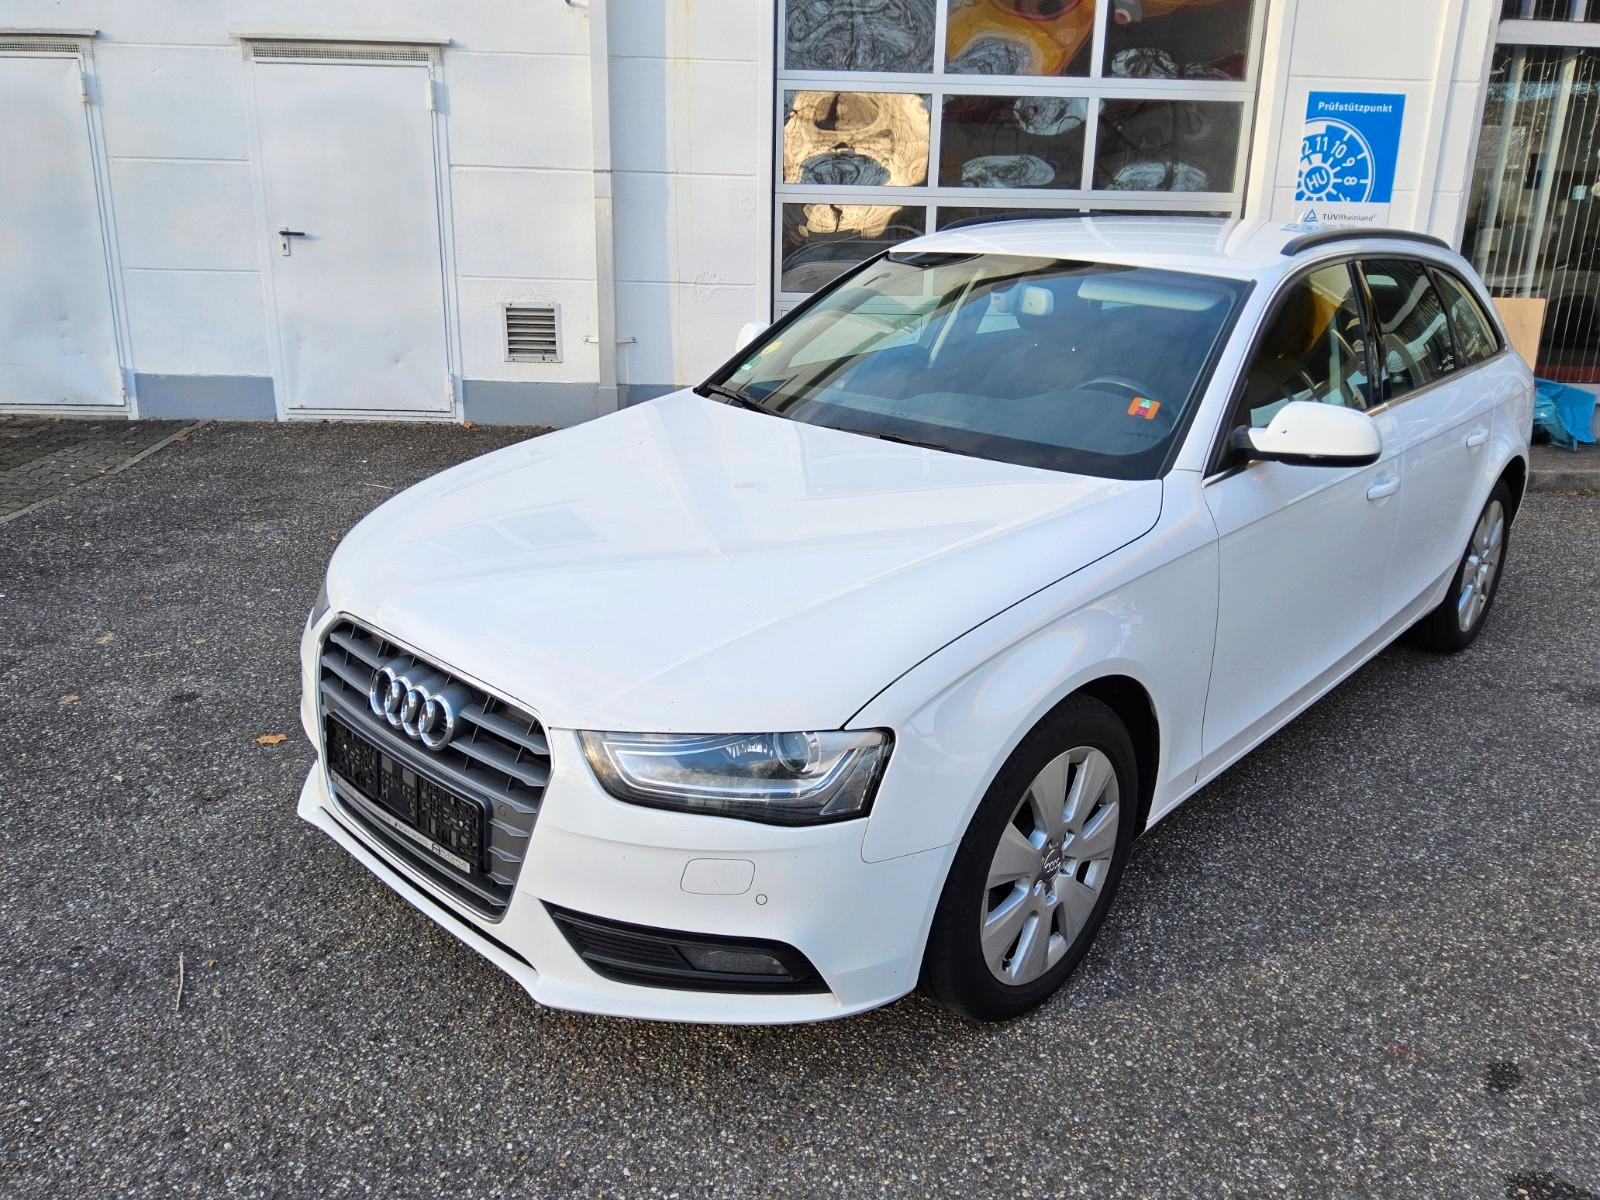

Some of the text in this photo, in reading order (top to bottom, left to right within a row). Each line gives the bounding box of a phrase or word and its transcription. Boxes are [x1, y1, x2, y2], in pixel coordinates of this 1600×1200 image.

[1318, 101, 1392, 113] Prüfstützpunkt
[1316, 136, 1328, 151] 11
[1330, 140, 1347, 158] 10
[1342, 157, 1356, 167] 9
[1306, 169, 1328, 191] HU
[1343, 176, 1358, 186] 8
